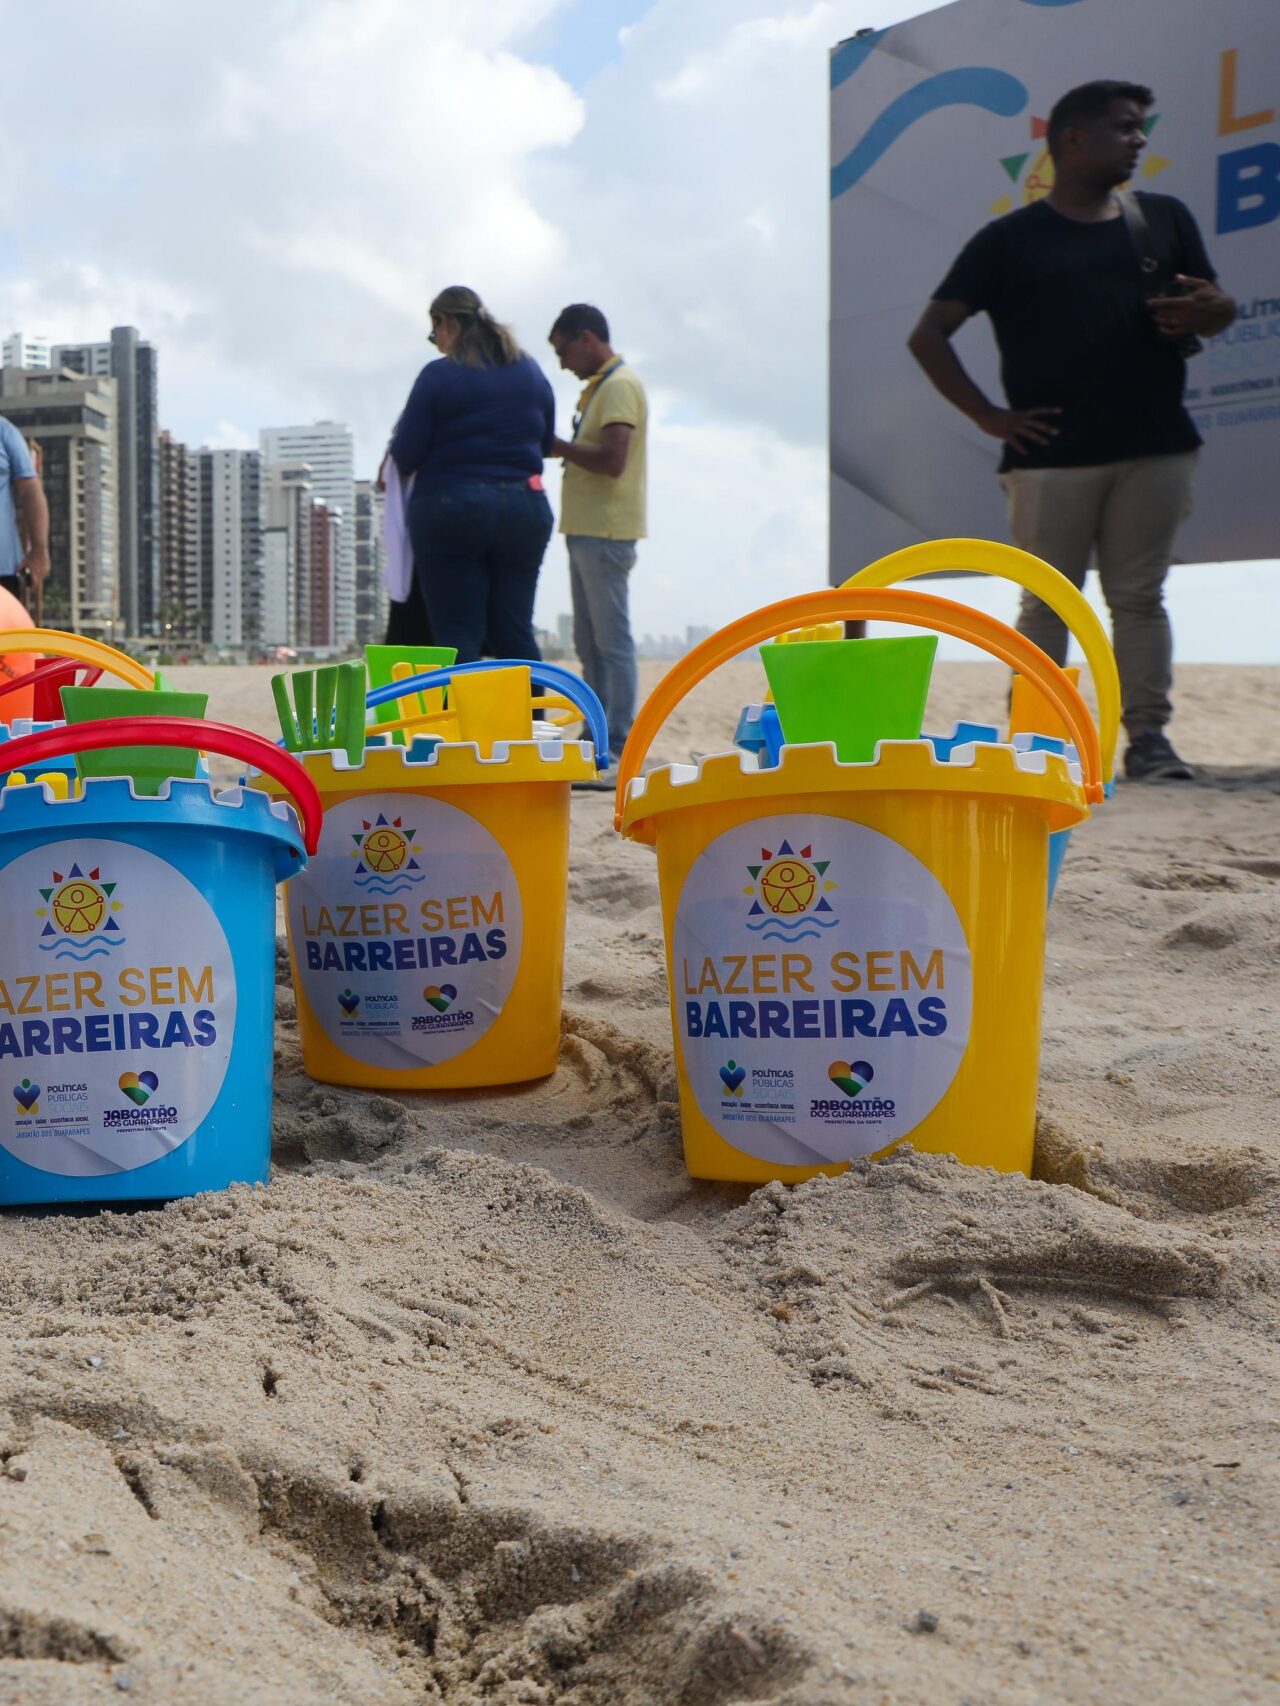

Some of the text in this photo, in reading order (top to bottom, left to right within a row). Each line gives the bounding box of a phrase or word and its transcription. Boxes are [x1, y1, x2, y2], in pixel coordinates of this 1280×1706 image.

[302, 892, 504, 937] LAZER SEM
[306, 928, 507, 972] BARREIRAS
[683, 949, 945, 995] LAZER SEM
[118, 966, 214, 1006] SEM
[412, 1010, 474, 1025] JABOATÃO
[686, 997, 948, 1039] BARREIRAS
[412, 1020, 474, 1031] DOS GUARARAPES
[752, 1068, 794, 1078] POLÍTICAS
[47, 1083, 87, 1093] POLÍTICAS
[752, 1078, 794, 1088] PÚBLICAS
[47, 1092, 88, 1103] PÚBLICAS
[810, 1097, 895, 1111] JABOATÃO
[103, 1104, 178, 1121] JABOATÃO
[810, 1110, 895, 1118] DOS GUARARAPES
[103, 1117, 178, 1128] DOS GUARARAPES
